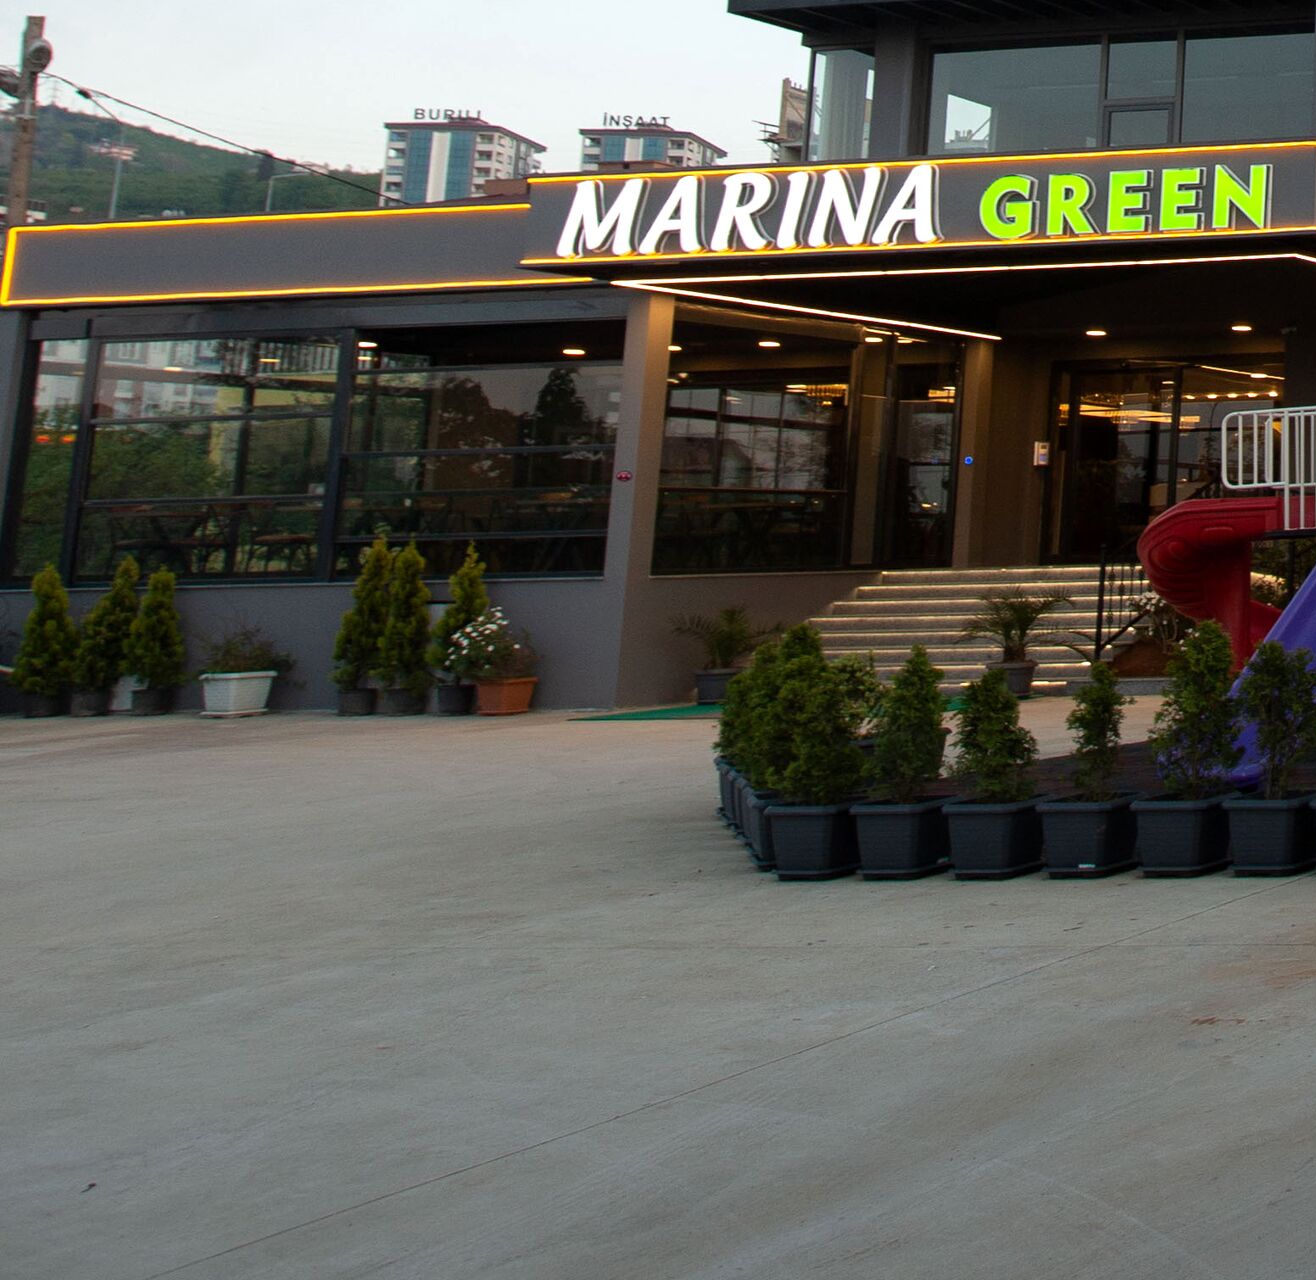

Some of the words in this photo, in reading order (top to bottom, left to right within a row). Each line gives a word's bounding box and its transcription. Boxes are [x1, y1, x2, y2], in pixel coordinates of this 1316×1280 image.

[603, 112, 671, 128] İNŞAAT
[556, 164, 944, 258] MARINA
[979, 164, 1272, 240] GREEN
